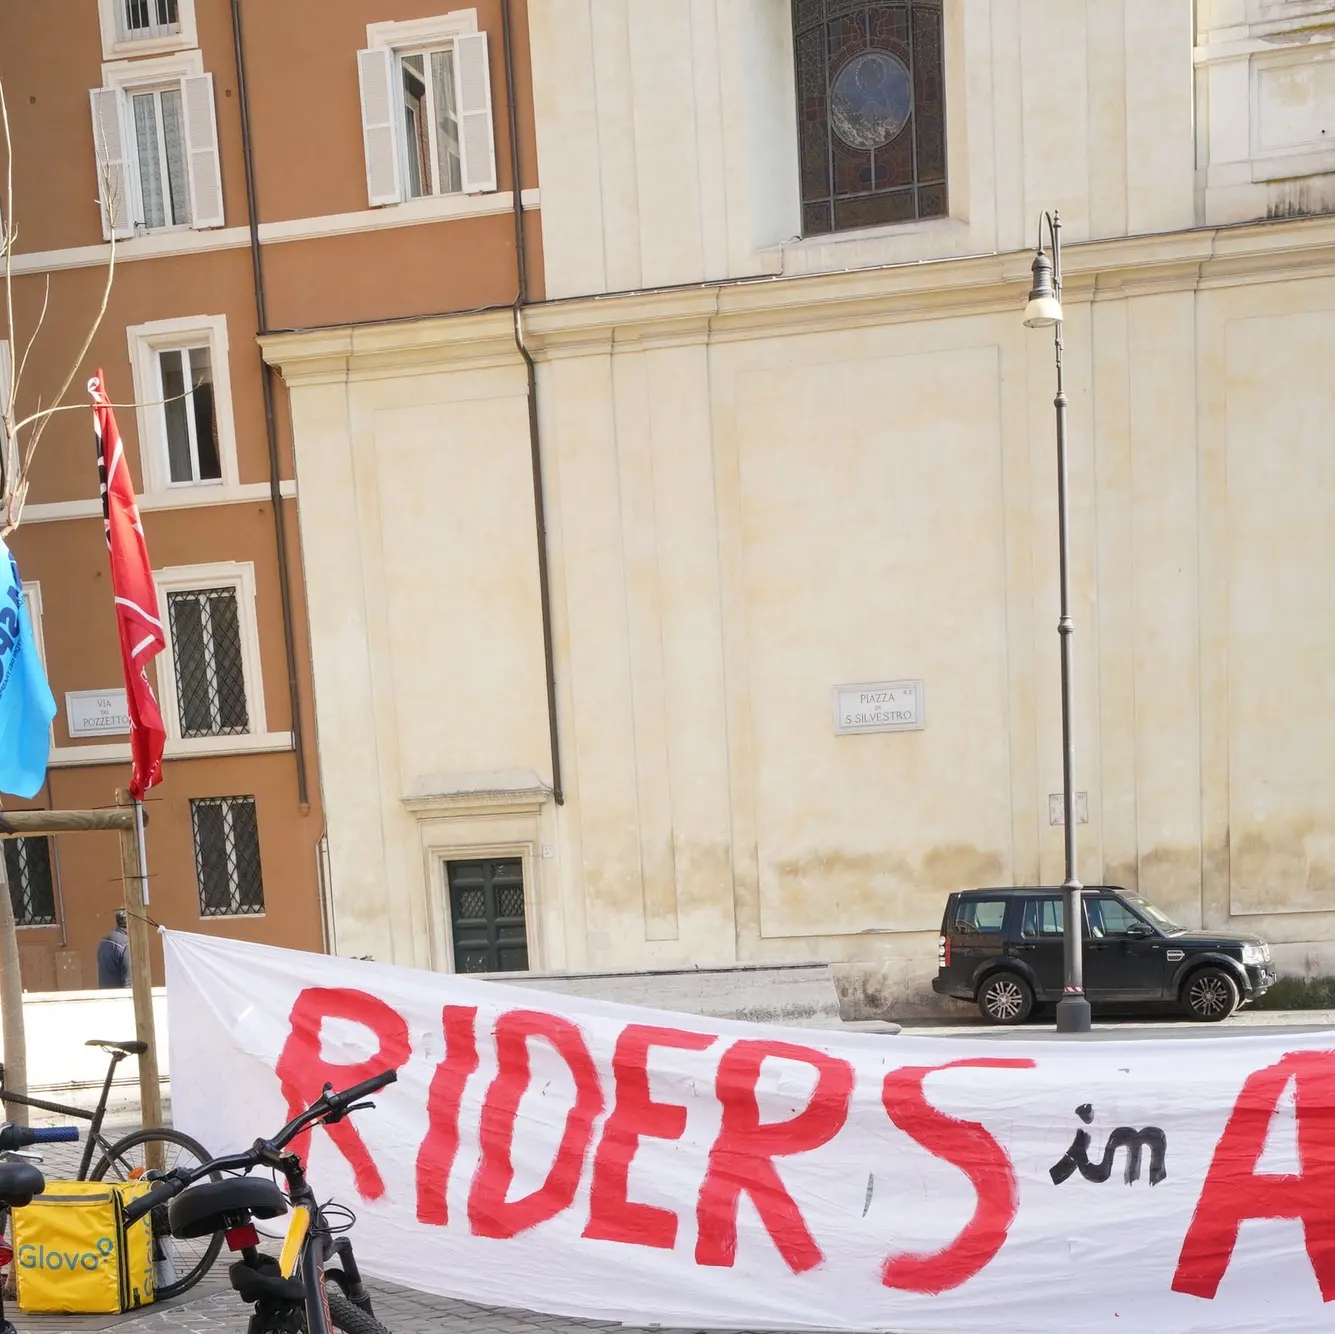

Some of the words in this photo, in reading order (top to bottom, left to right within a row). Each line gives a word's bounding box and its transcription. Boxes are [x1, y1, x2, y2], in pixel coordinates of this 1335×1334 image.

[96, 700, 112, 708] VIA
[859, 692, 895, 704] PIAZZA
[83, 716, 129, 727] POZZETTO
[855, 710, 912, 724] SILVESTRO
[276, 987, 1037, 1295] RIDERS
[1049, 1103, 1166, 1186] in
[18, 1244, 99, 1271] Glovo
